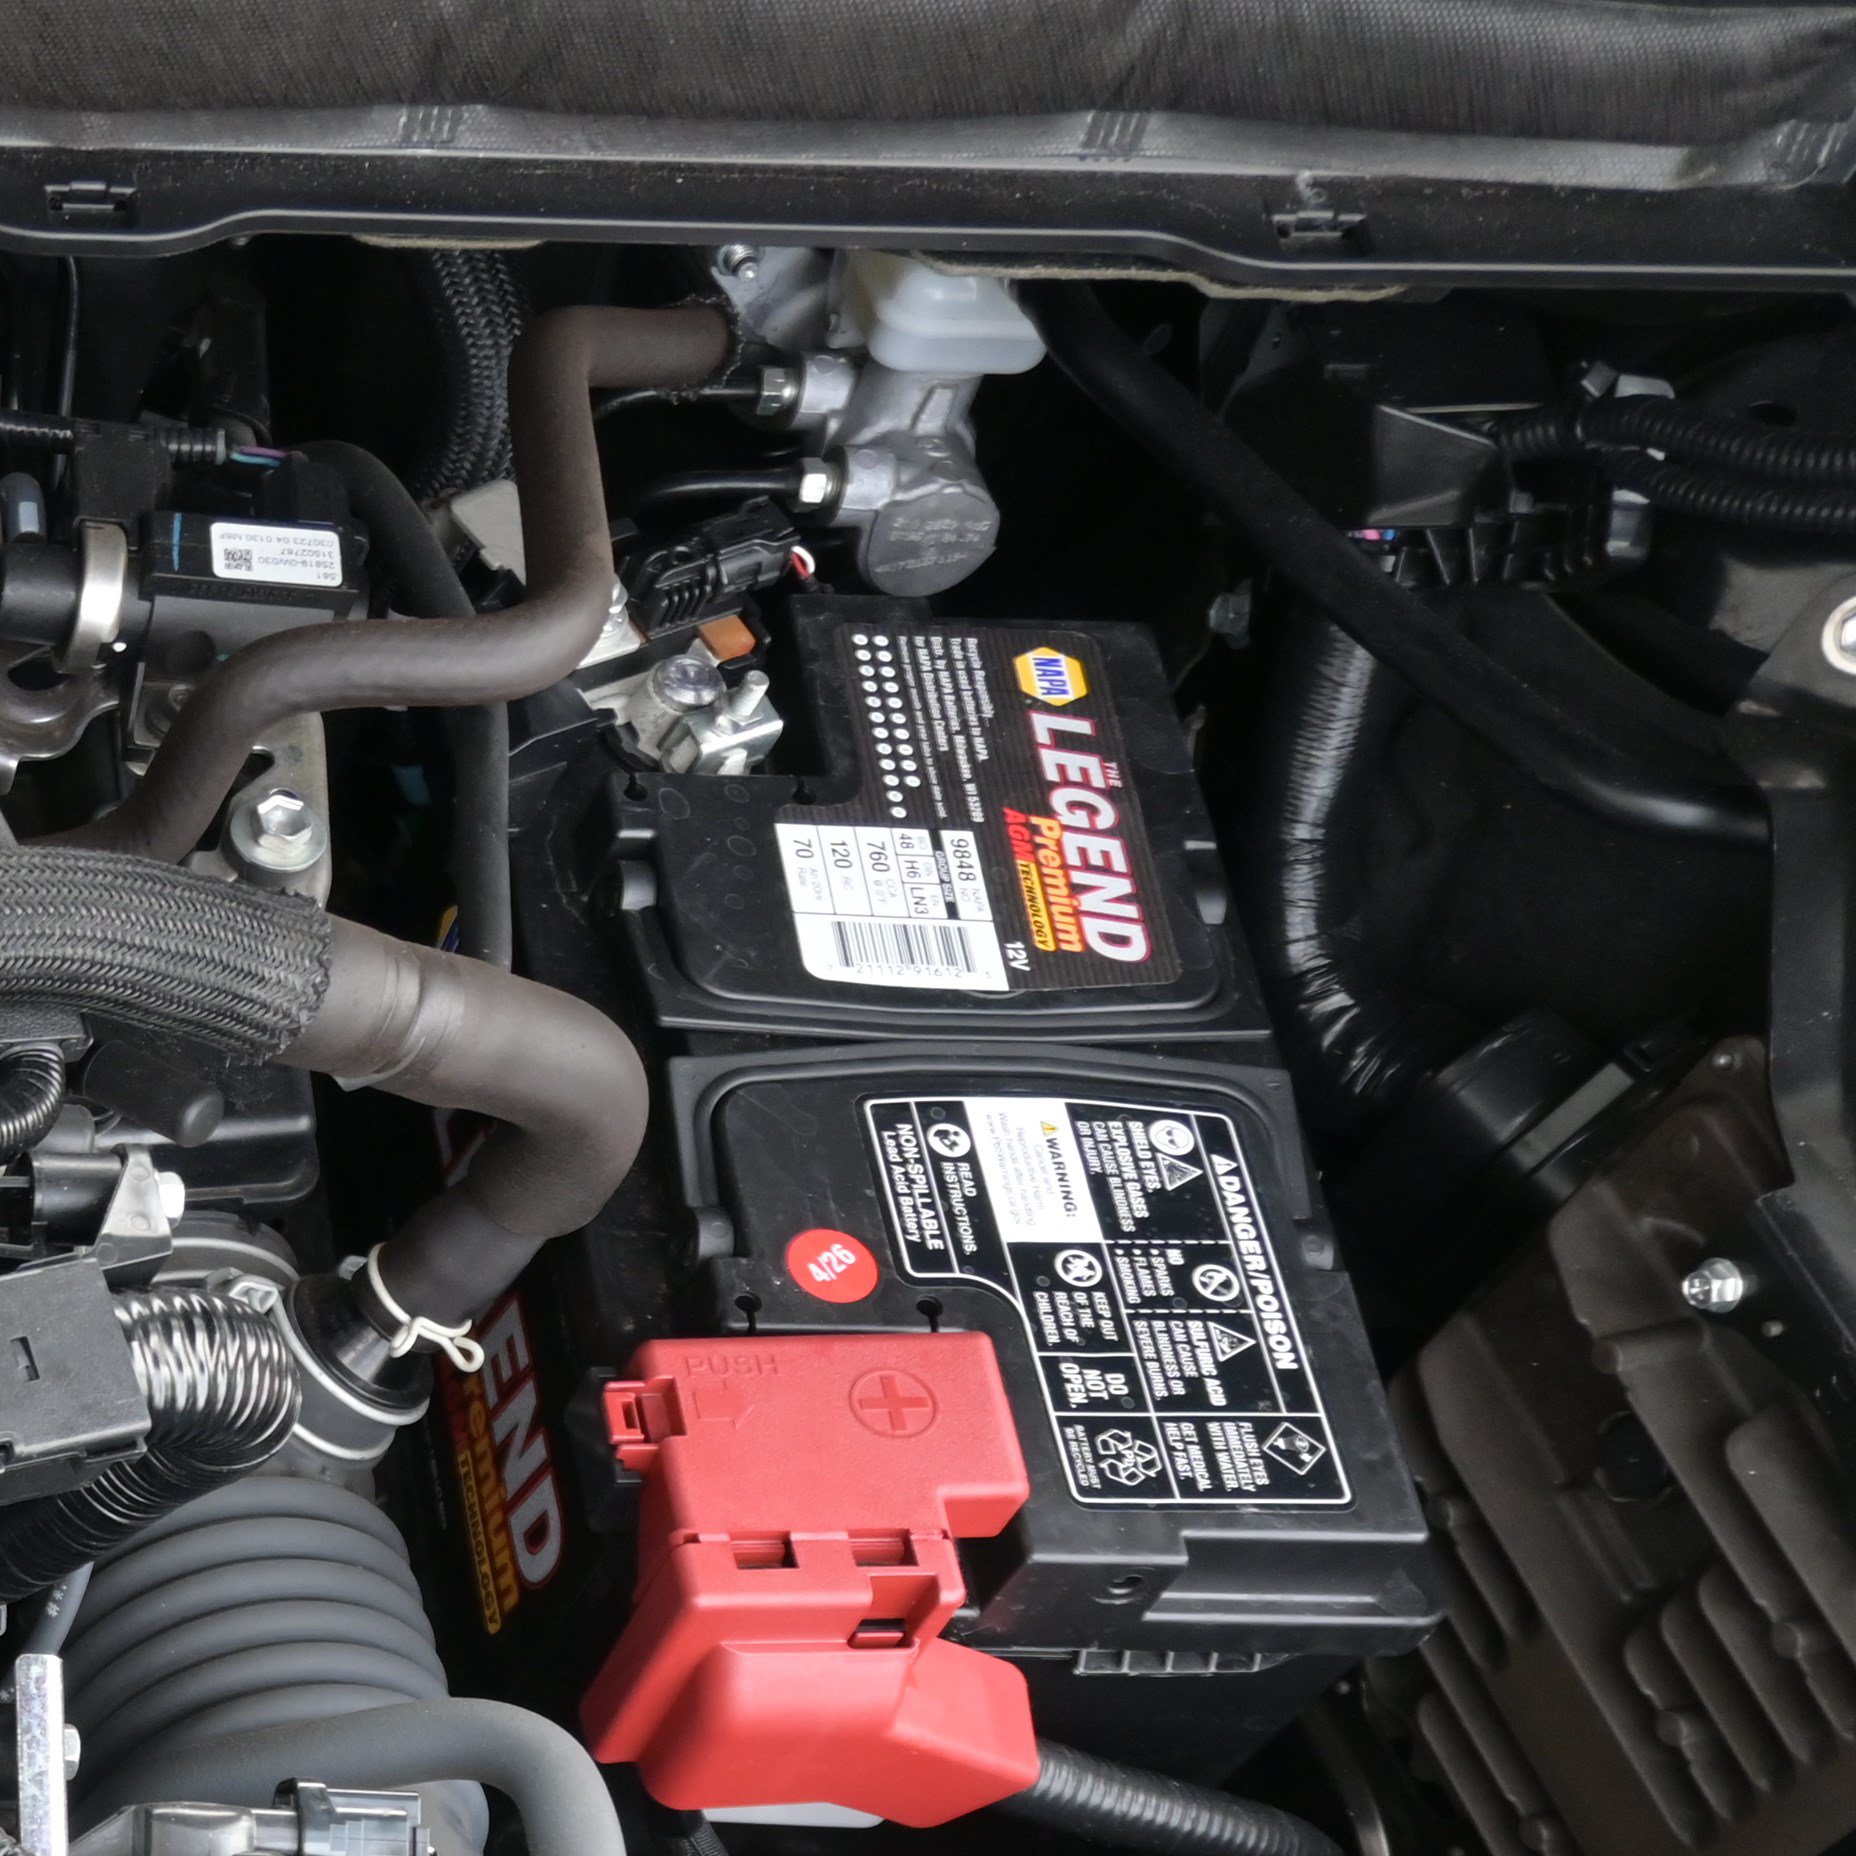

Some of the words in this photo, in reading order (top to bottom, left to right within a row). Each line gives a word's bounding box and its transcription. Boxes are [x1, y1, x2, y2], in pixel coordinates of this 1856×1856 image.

[317, 572, 337, 581] 581
[916, 648, 933, 671] NAPA
[1031, 652, 1071, 699] NAPA
[922, 672, 942, 718] Distribution
[938, 671, 954, 693] NAPA
[933, 720, 949, 752] Centers
[1105, 762, 1121, 788] THE
[792, 838, 815, 859] 70
[898, 833, 916, 849] 48
[1003, 807, 1034, 860] AGM
[1028, 710, 1150, 963] LEGEND
[829, 839, 853, 869] 120
[866, 841, 891, 873] 760
[904, 859, 922, 879] H6
[934, 850, 951, 883] GROUP
[950, 838, 977, 882] 9848
[909, 886, 930, 915] LN3
[940, 883, 955, 903] SIZE
[1029, 815, 1086, 953] Premium
[1018, 860, 1054, 951] TECHNOLOGY
[1004, 941, 1031, 972] 12V
[1075, 1121, 1091, 1136] OR
[1092, 1121, 1108, 1141] CAN
[1127, 1121, 1153, 1159] SHIELD
[881, 1131, 901, 1162] Lead
[1098, 1143, 1118, 1175] CAUSE
[890, 1165, 910, 1194] Acid
[956, 1162, 977, 1197] READ
[1044, 1137, 1077, 1218] WARNING:
[1107, 1121, 1137, 1180] EXPLOSIVE
[1126, 1182, 1149, 1218] GASES
[895, 1124, 945, 1250] NON-SPILLABLE
[900, 1196, 922, 1243] Battery
[1108, 1177, 1135, 1232] BLINDNESS
[806, 1243, 857, 1286] 4/26
[1167, 1249, 1184, 1265] NO
[1217, 1172, 1299, 1371] DANGER/POISON
[1114, 1256, 1140, 1304] SMOKING
[1132, 1257, 1155, 1297] FLAMES
[1150, 1257, 1175, 1297] SPARKS
[1073, 1292, 1089, 1306] OF
[1092, 1291, 1112, 1318] KEEP
[1052, 1291, 1075, 1327] REACH
[1064, 1329, 1079, 1343] OF
[1079, 1308, 1095, 1328] THE
[1100, 1320, 1118, 1341] OUT
[1170, 1320, 1186, 1341] CAN
[1132, 1320, 1155, 1359] SEVERE
[685, 1353, 778, 1378] PUSH
[1152, 1320, 1180, 1378] BLINDNESS
[1170, 1380, 1186, 1395] OR
[1177, 1343, 1198, 1378] CAUSE
[1187, 1320, 1216, 1376] SULFURIC
[1204, 1377, 1226, 1406] ACID
[1058, 1362, 1088, 1408] OPEN.
[1082, 1369, 1109, 1400] NOT
[1106, 1373, 1129, 1395] DO
[1074, 1425, 1095, 1464] BATTERY
[1162, 1422, 1182, 1450] HELP
[1179, 1422, 1196, 1443] GET
[1206, 1422, 1227, 1450] WITH
[1186, 1445, 1211, 1491] MEDICAL
[1222, 1422, 1256, 1492] IMMEDIATELY
[1238, 1422, 1258, 1457] FLUSH
[1250, 1458, 1269, 1486] EYES
[466, 1379, 520, 1613] remium
[458, 1454, 497, 1628] TECHNOLOGY
